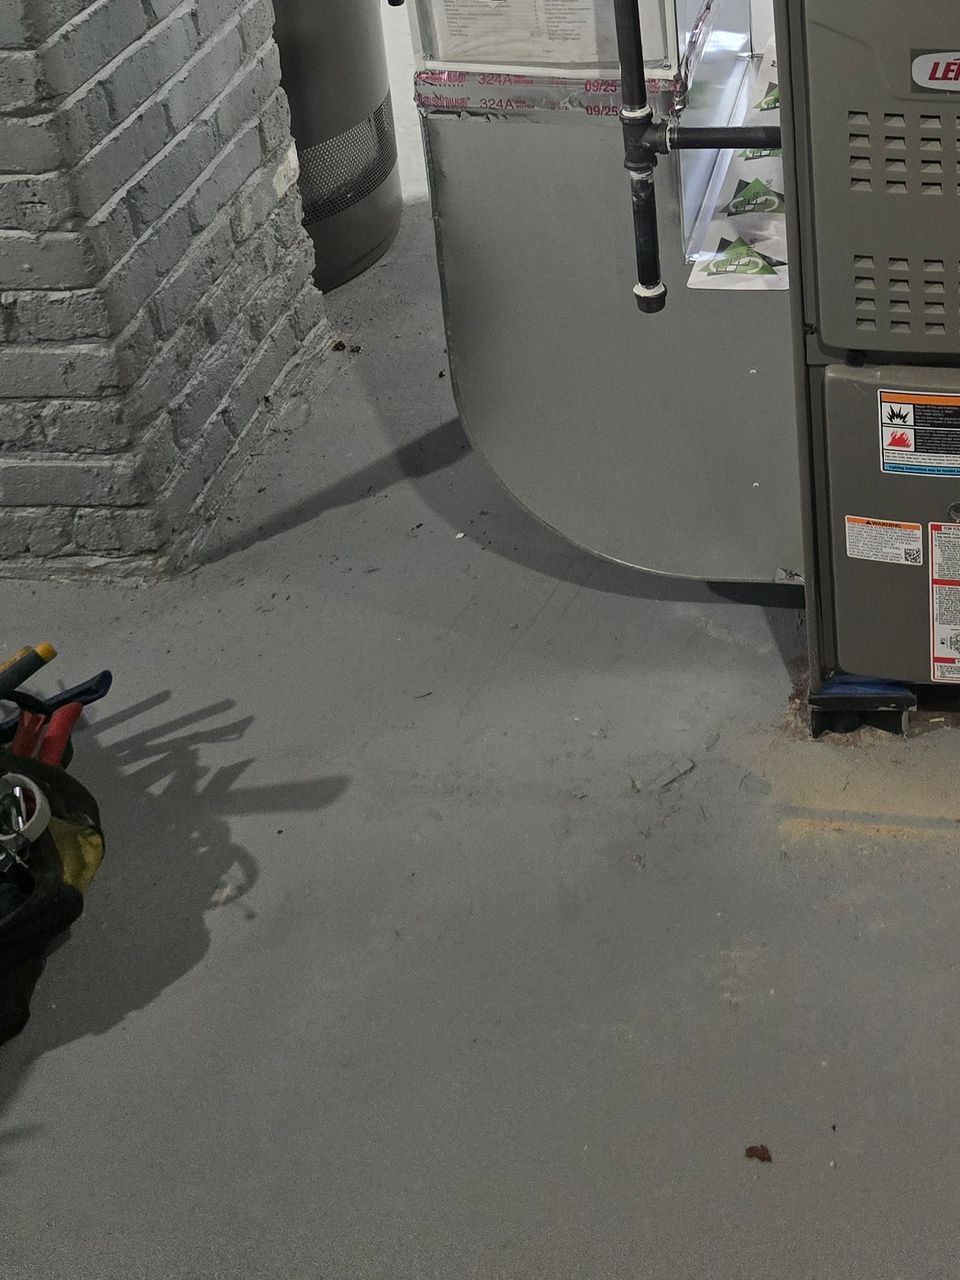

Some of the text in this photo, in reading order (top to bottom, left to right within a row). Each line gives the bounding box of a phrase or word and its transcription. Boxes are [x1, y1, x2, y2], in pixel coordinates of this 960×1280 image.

[478, 72, 513, 85] 324A
[584, 79, 618, 93] 09/25
[480, 98, 515, 110] 324A
[586, 104, 619, 117] 09/25
[872, 520, 902, 528] WARNING
